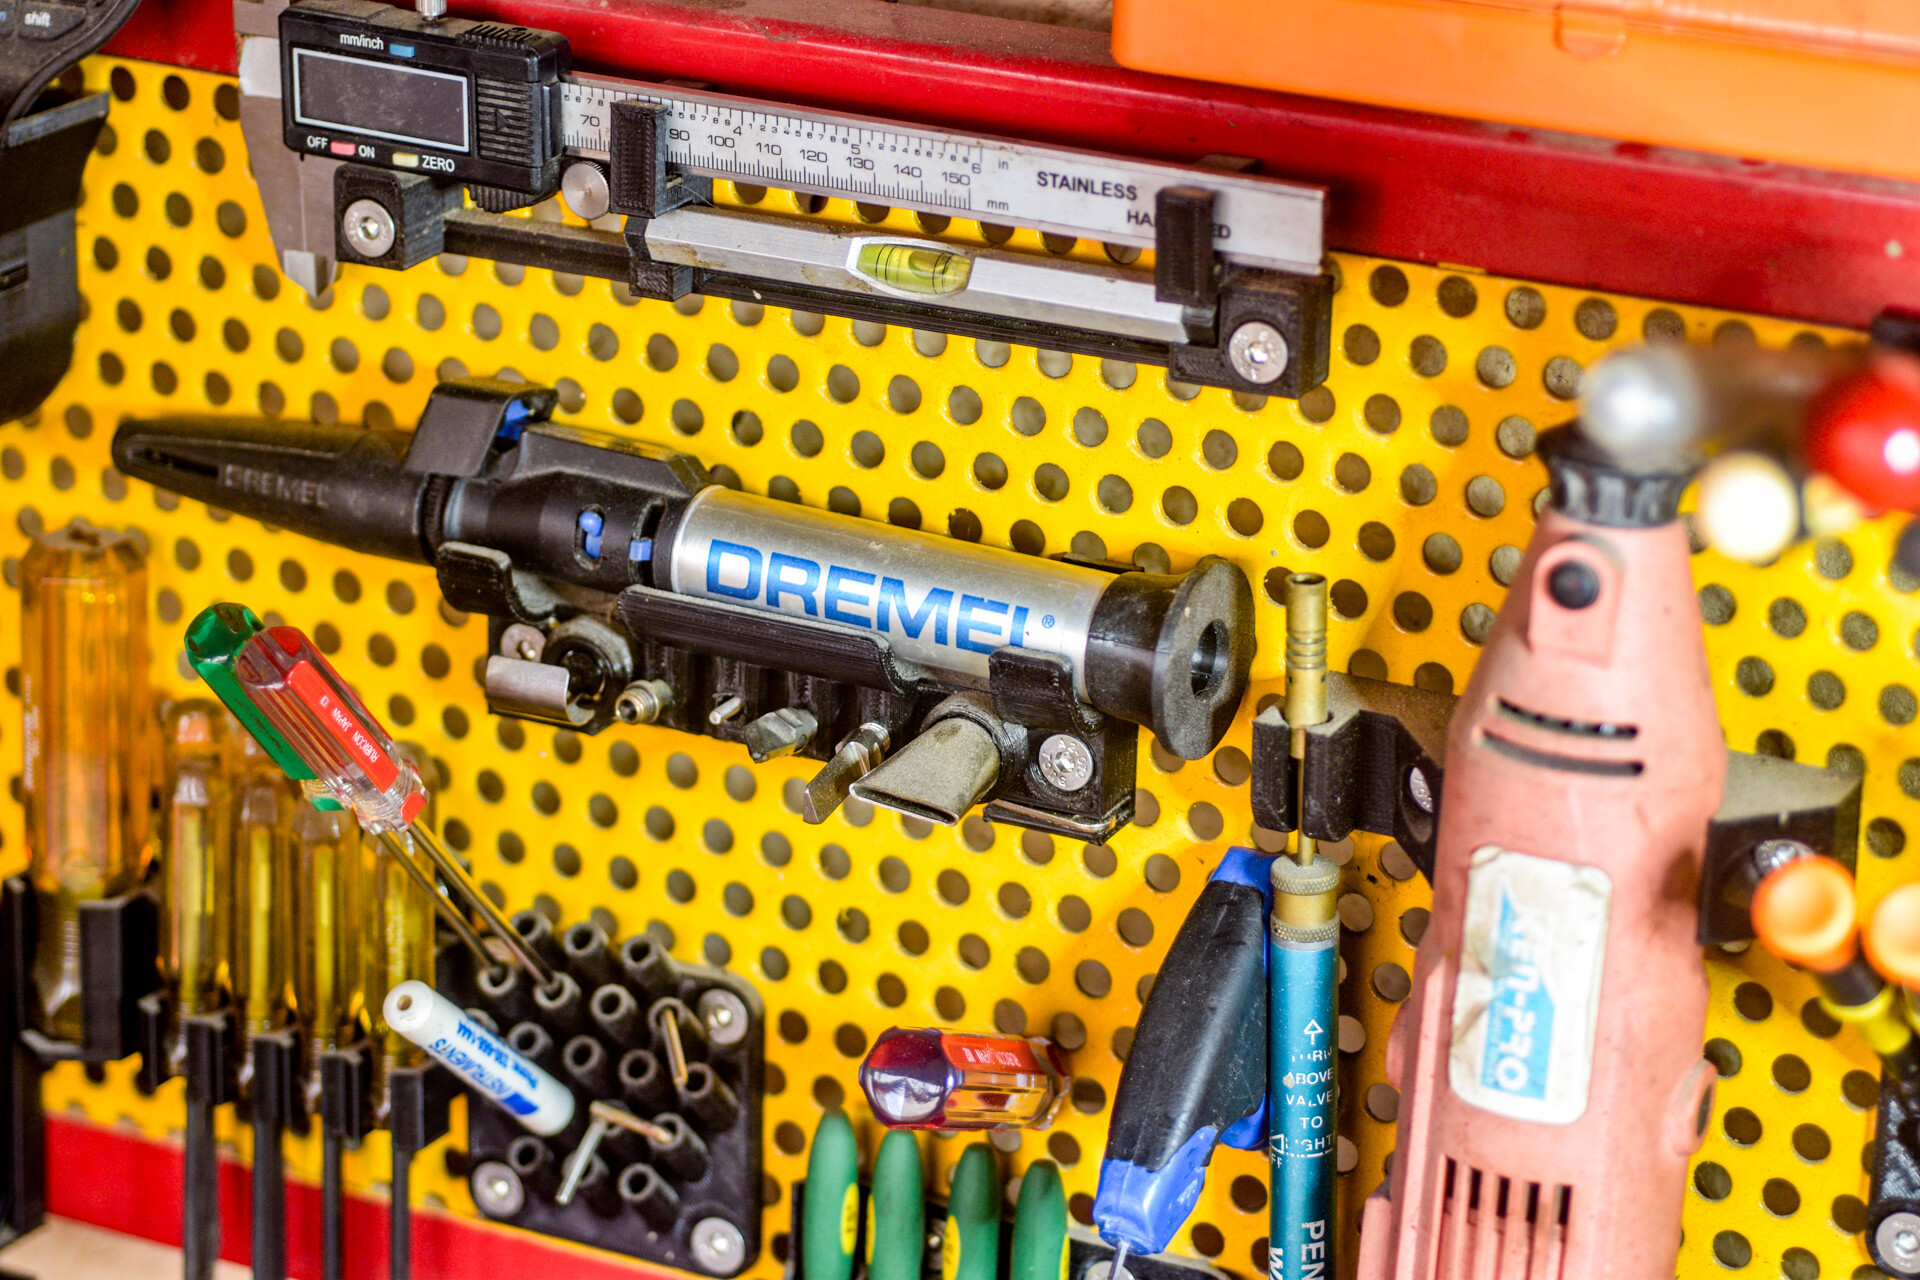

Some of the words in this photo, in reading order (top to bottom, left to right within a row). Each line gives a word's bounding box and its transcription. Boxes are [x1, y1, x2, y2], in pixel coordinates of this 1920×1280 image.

[24, 11, 51, 28] shift
[340, 33, 384, 50] mm/inch
[307, 136, 328, 149] OFF
[358, 145, 376, 159] ON
[422, 155, 455, 172] ZERO
[580, 114, 600, 127] 70
[669, 128, 690, 141] 90
[707, 134, 735, 148] 100
[756, 142, 782, 156] 110
[800, 149, 828, 163] 120
[846, 156, 875, 171] 130
[893, 164, 922, 178] 140
[941, 171, 971, 186] 150
[987, 199, 1009, 211] mm
[733, 126, 742, 136] 4
[850, 143, 861, 155] 5
[971, 162, 982, 174] 6
[998, 159, 1009, 170] in
[1037, 171, 1138, 201] STAINLESS
[225, 464, 330, 508] DREMEL
[332, 707, 353, 732] JAPAN
[352, 731, 380, 763] RUBICON
[1286, 1089, 1333, 1107] VALVE
[1299, 1115, 1323, 1129] TO
